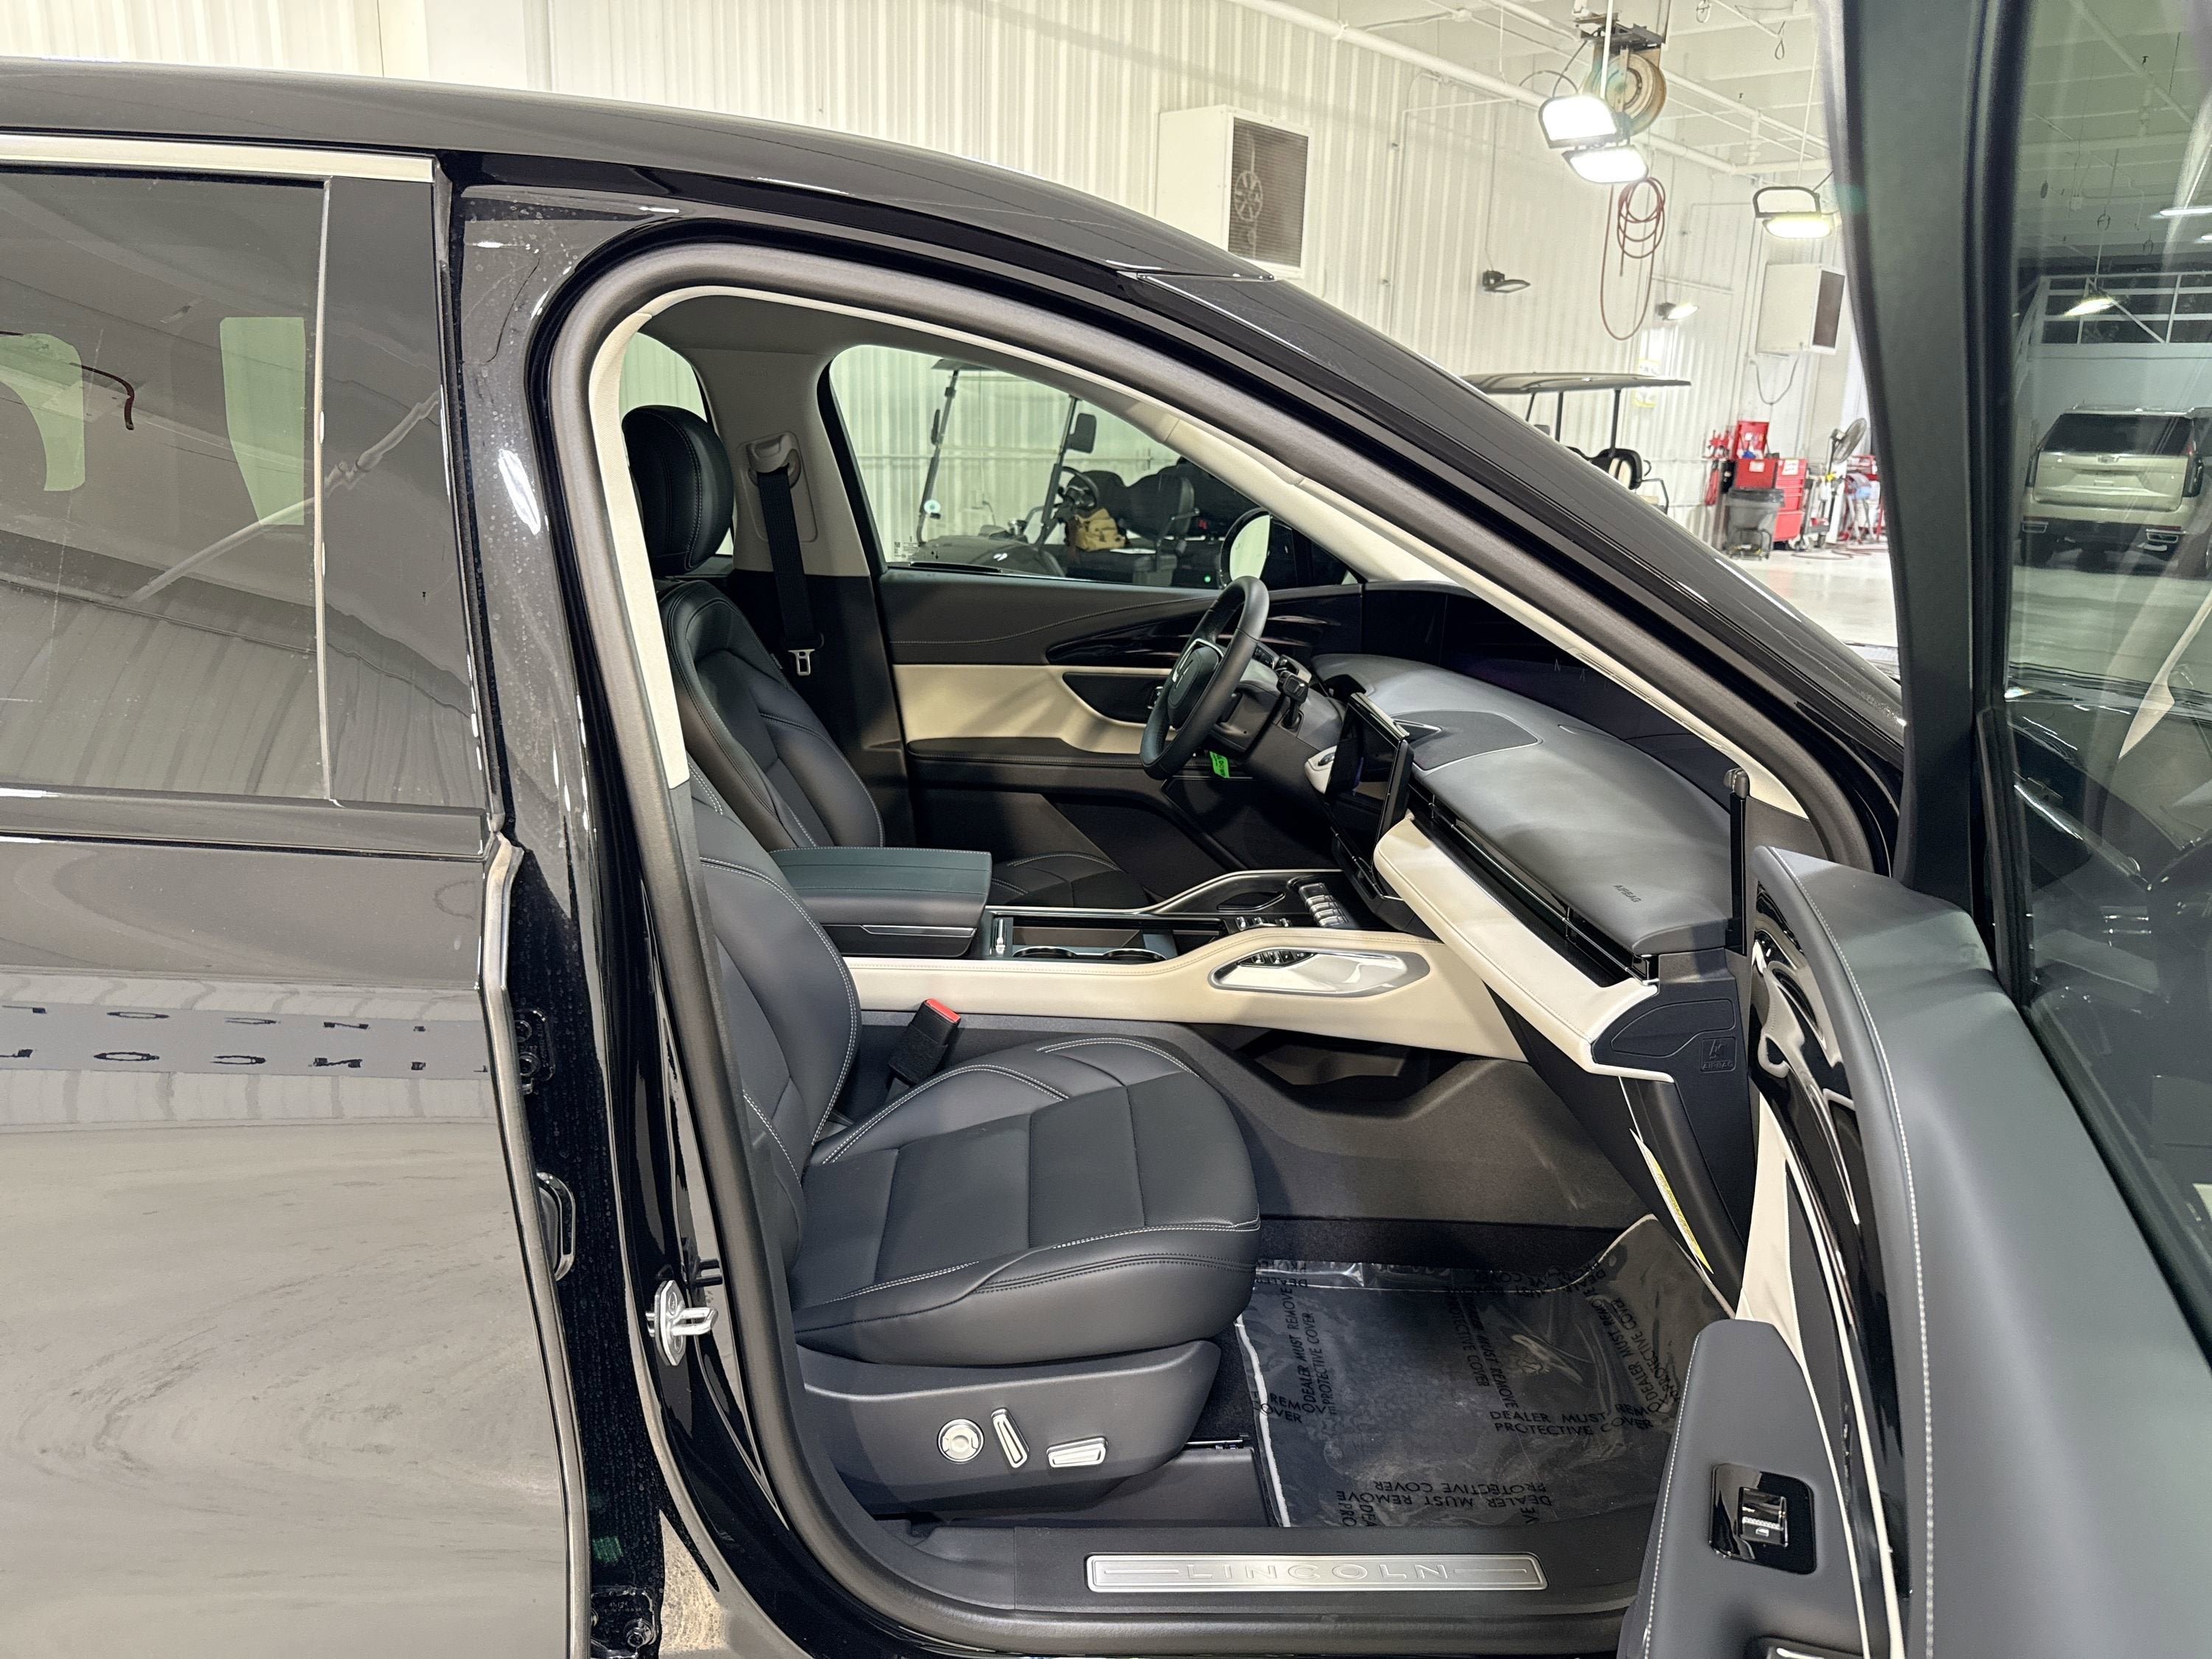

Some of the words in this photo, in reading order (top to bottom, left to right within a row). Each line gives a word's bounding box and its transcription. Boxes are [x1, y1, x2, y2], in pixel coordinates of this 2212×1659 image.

[1612, 884, 1641, 902] AIRBAG
[1703, 1062, 1734, 1071] AIRBAG
[1280, 1288, 1300, 1329] REMOVE
[1301, 1312, 1320, 1344] COVER
[1289, 1335, 1308, 1362] MUST
[1607, 1330, 1635, 1358] MUST
[1298, 1366, 1316, 1402] DEALER
[1310, 1348, 1334, 1405] PROTECTIVE
[1628, 1361, 1658, 1401] DEALER
[1490, 1411, 1551, 1423] DEALER
[1562, 1411, 1607, 1423] MUST
[1495, 1423, 1594, 1436] PROTECTIVE
[1601, 1417, 1654, 1433] COVER
[1374, 1481, 1433, 1493] COVER
[1441, 1482, 1547, 1495] PROTECTIVE
[1336, 1490, 1412, 1505] REMOVE
[1425, 1496, 1475, 1508] MUST
[1486, 1495, 1552, 1508] DEALER
[1186, 1564, 1448, 1580] LINCOLN
